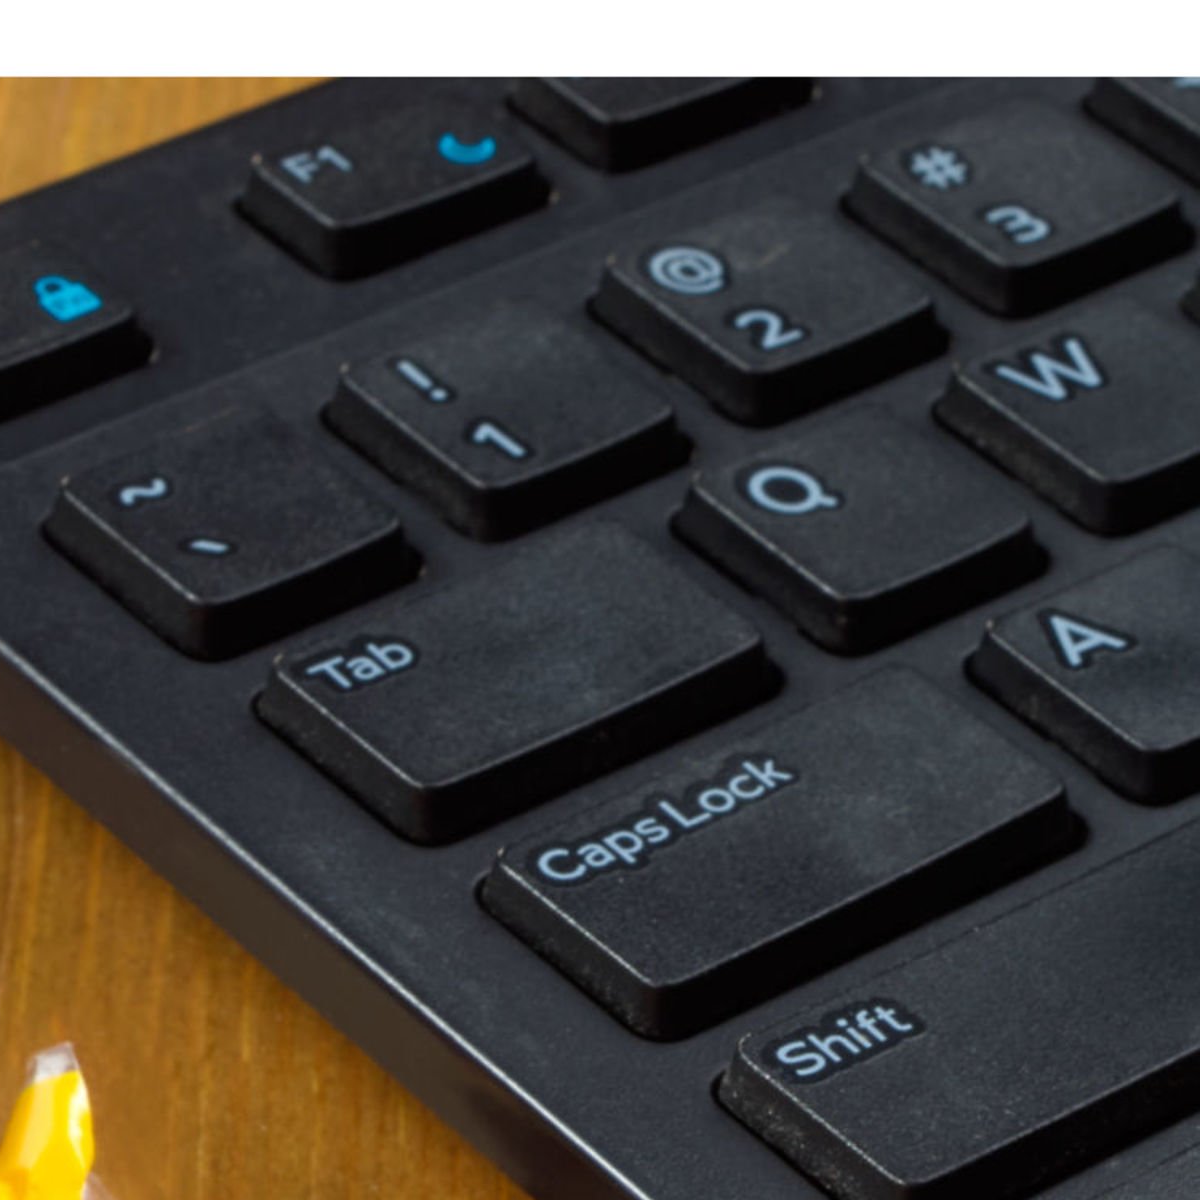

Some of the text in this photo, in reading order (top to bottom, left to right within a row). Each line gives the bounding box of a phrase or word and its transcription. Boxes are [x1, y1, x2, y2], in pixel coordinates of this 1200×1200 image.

[281, 146, 352, 183] F1
[910, 146, 967, 189] #
[986, 205, 1050, 244] 3
[648, 246, 724, 295] @
[735, 309, 803, 349] 2
[398, 360, 448, 401] !
[996, 338, 1102, 401] W
[473, 422, 526, 458] 1
[746, 466, 838, 515] Q
[1048, 614, 1128, 667] A
[306, 640, 414, 691] Tab
[536, 755, 794, 883] Caps Lock
[775, 1004, 914, 1078] Shift
